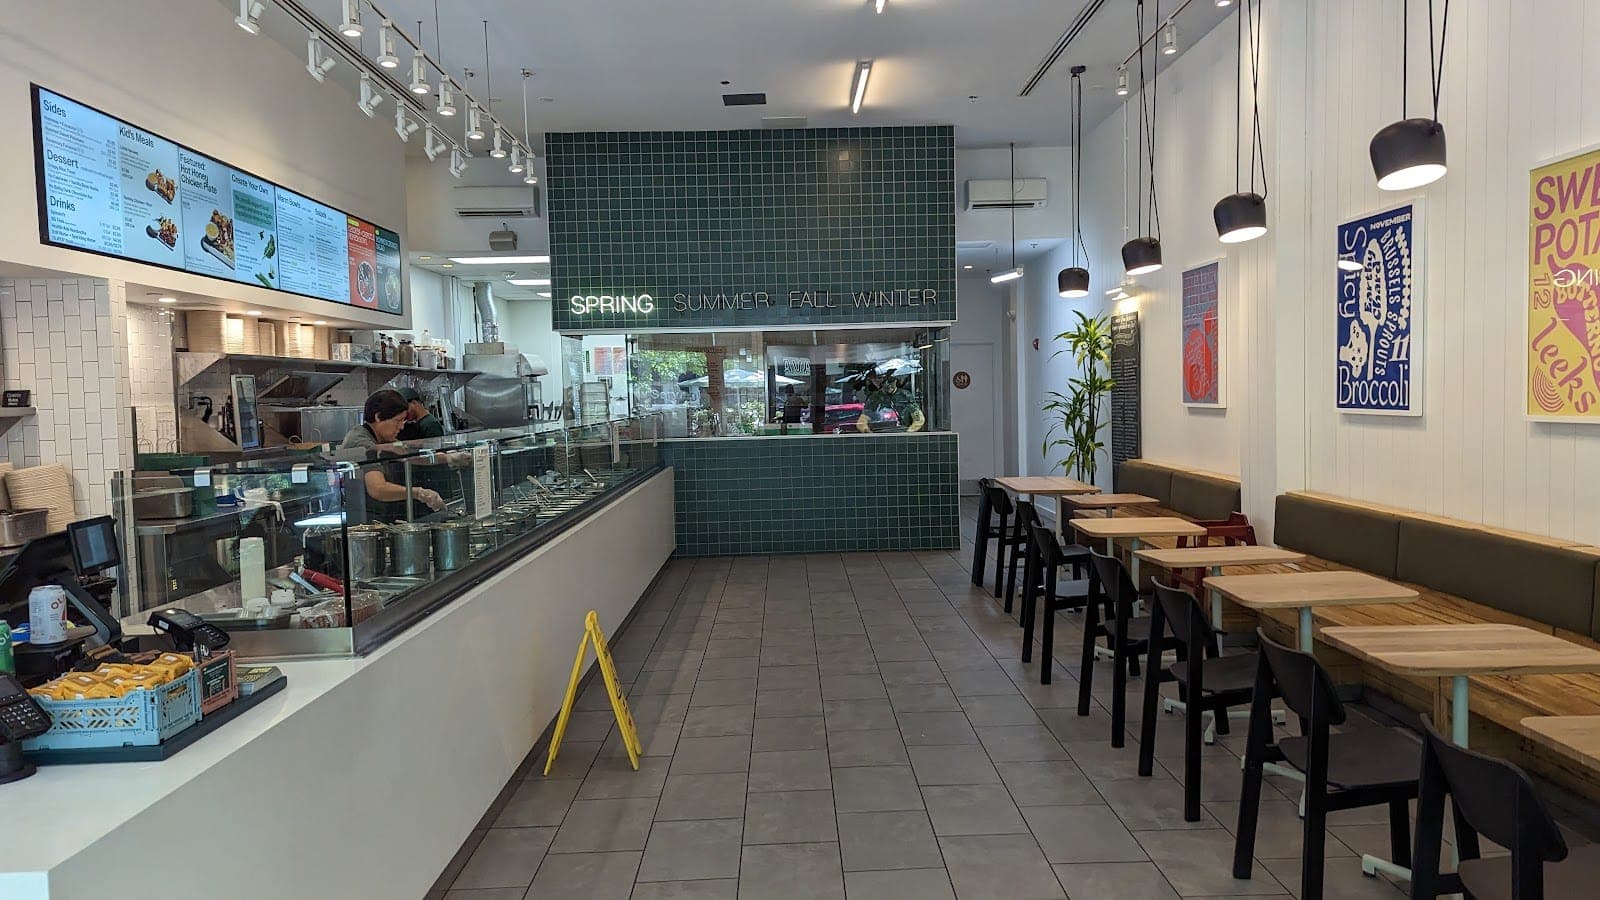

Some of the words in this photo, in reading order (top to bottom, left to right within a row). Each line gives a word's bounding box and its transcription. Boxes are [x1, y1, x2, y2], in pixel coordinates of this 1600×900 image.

[43, 100, 67, 118] Sides
[119, 127, 135, 141] Kid's
[136, 132, 154, 148] Meals
[47, 149, 79, 169] Dessert
[191, 168, 209, 182] Honey
[232, 174, 248, 187] Create
[203, 181, 218, 195] Plate
[50, 195, 76, 212] Drinks
[1370, 213, 1411, 231] NOVEMBER
[1381, 229, 1401, 305] BRUSSELS
[571, 294, 654, 315] SPRING
[673, 291, 769, 312] SUMMER
[789, 290, 837, 309] FALL
[851, 288, 937, 309] WINTER
[1374, 311, 1398, 376] SPROUTS
[1388, 333, 1410, 361] 11
[1338, 363, 1409, 407] Broccoli
